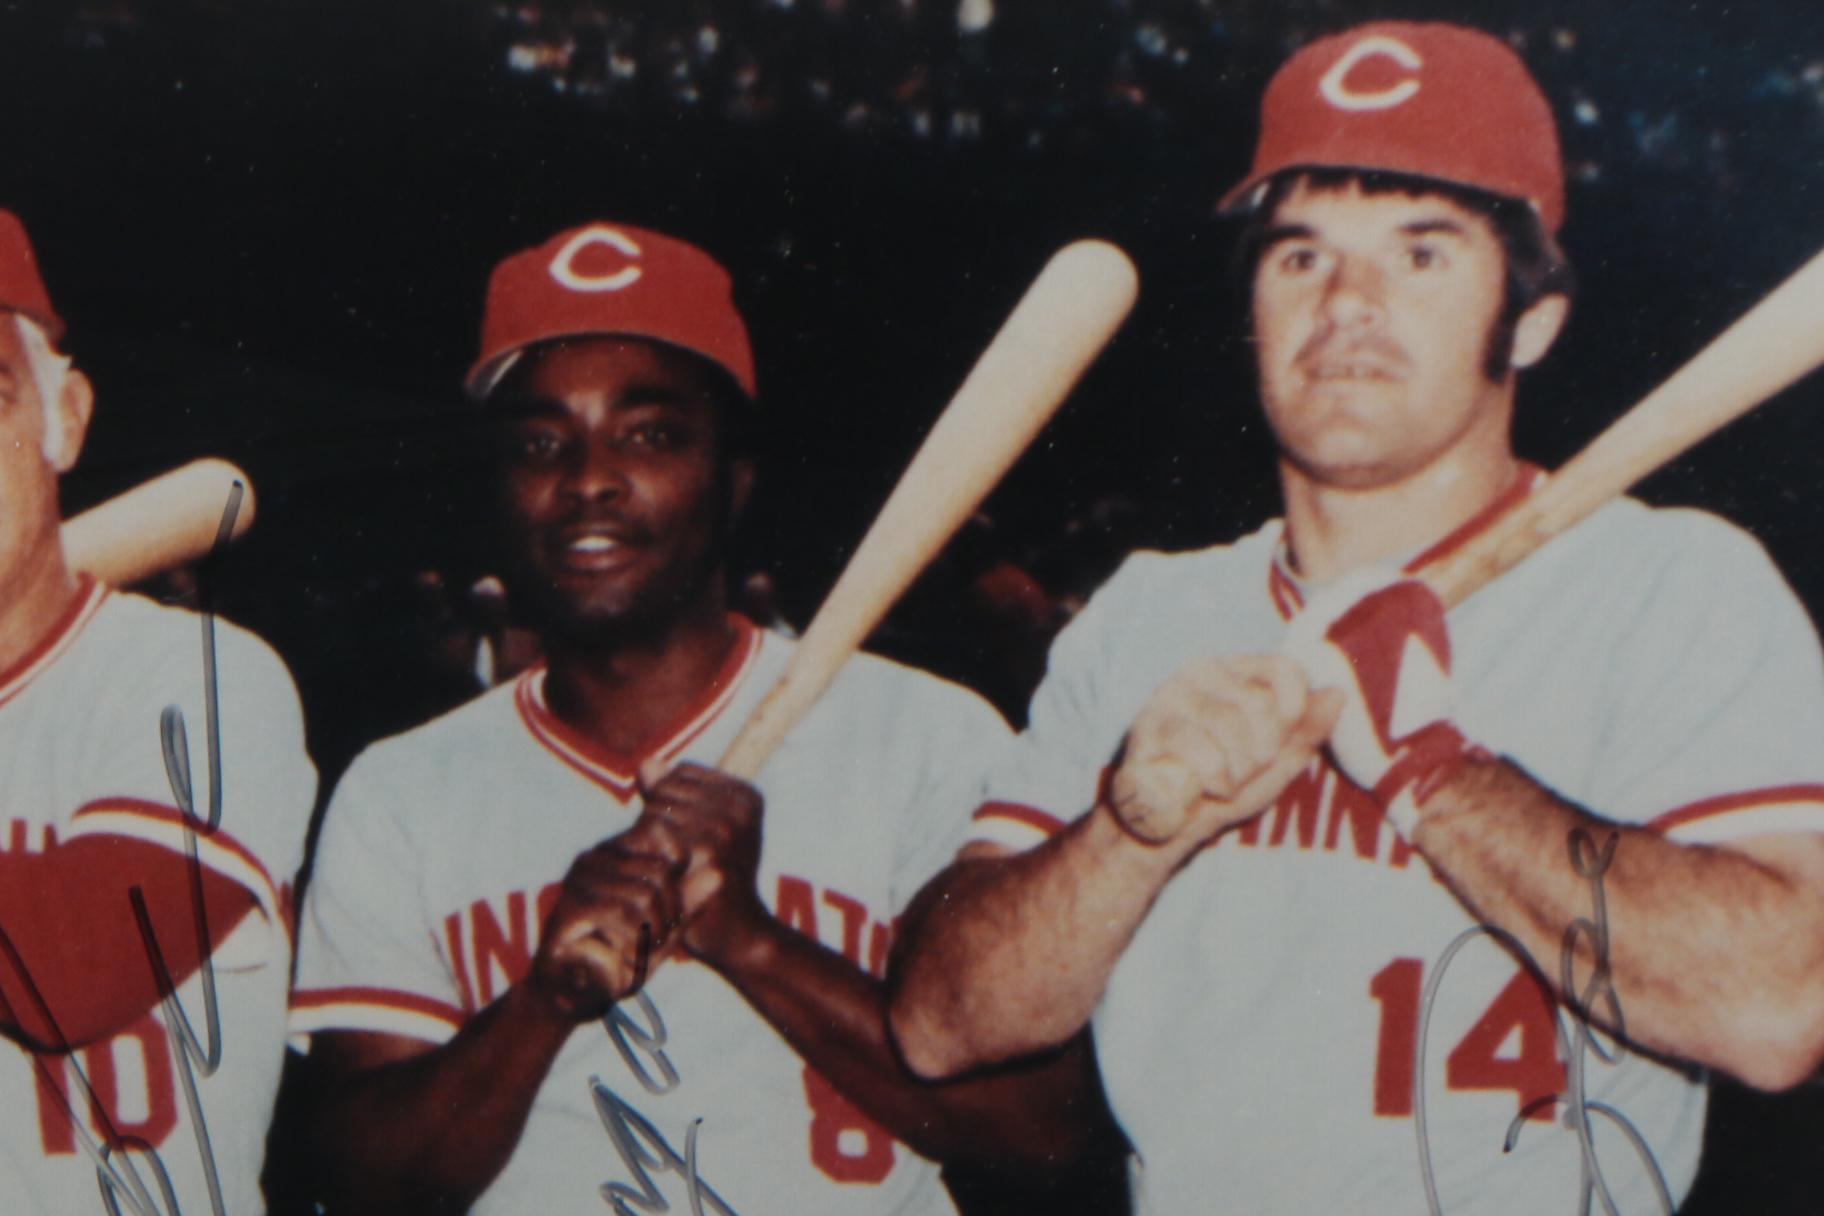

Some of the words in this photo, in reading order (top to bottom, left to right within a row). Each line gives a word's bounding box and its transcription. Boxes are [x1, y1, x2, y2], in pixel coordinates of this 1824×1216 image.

[1319, 36, 1422, 112] C
[548, 224, 643, 292] C
[1369, 956, 1569, 1124] 14
